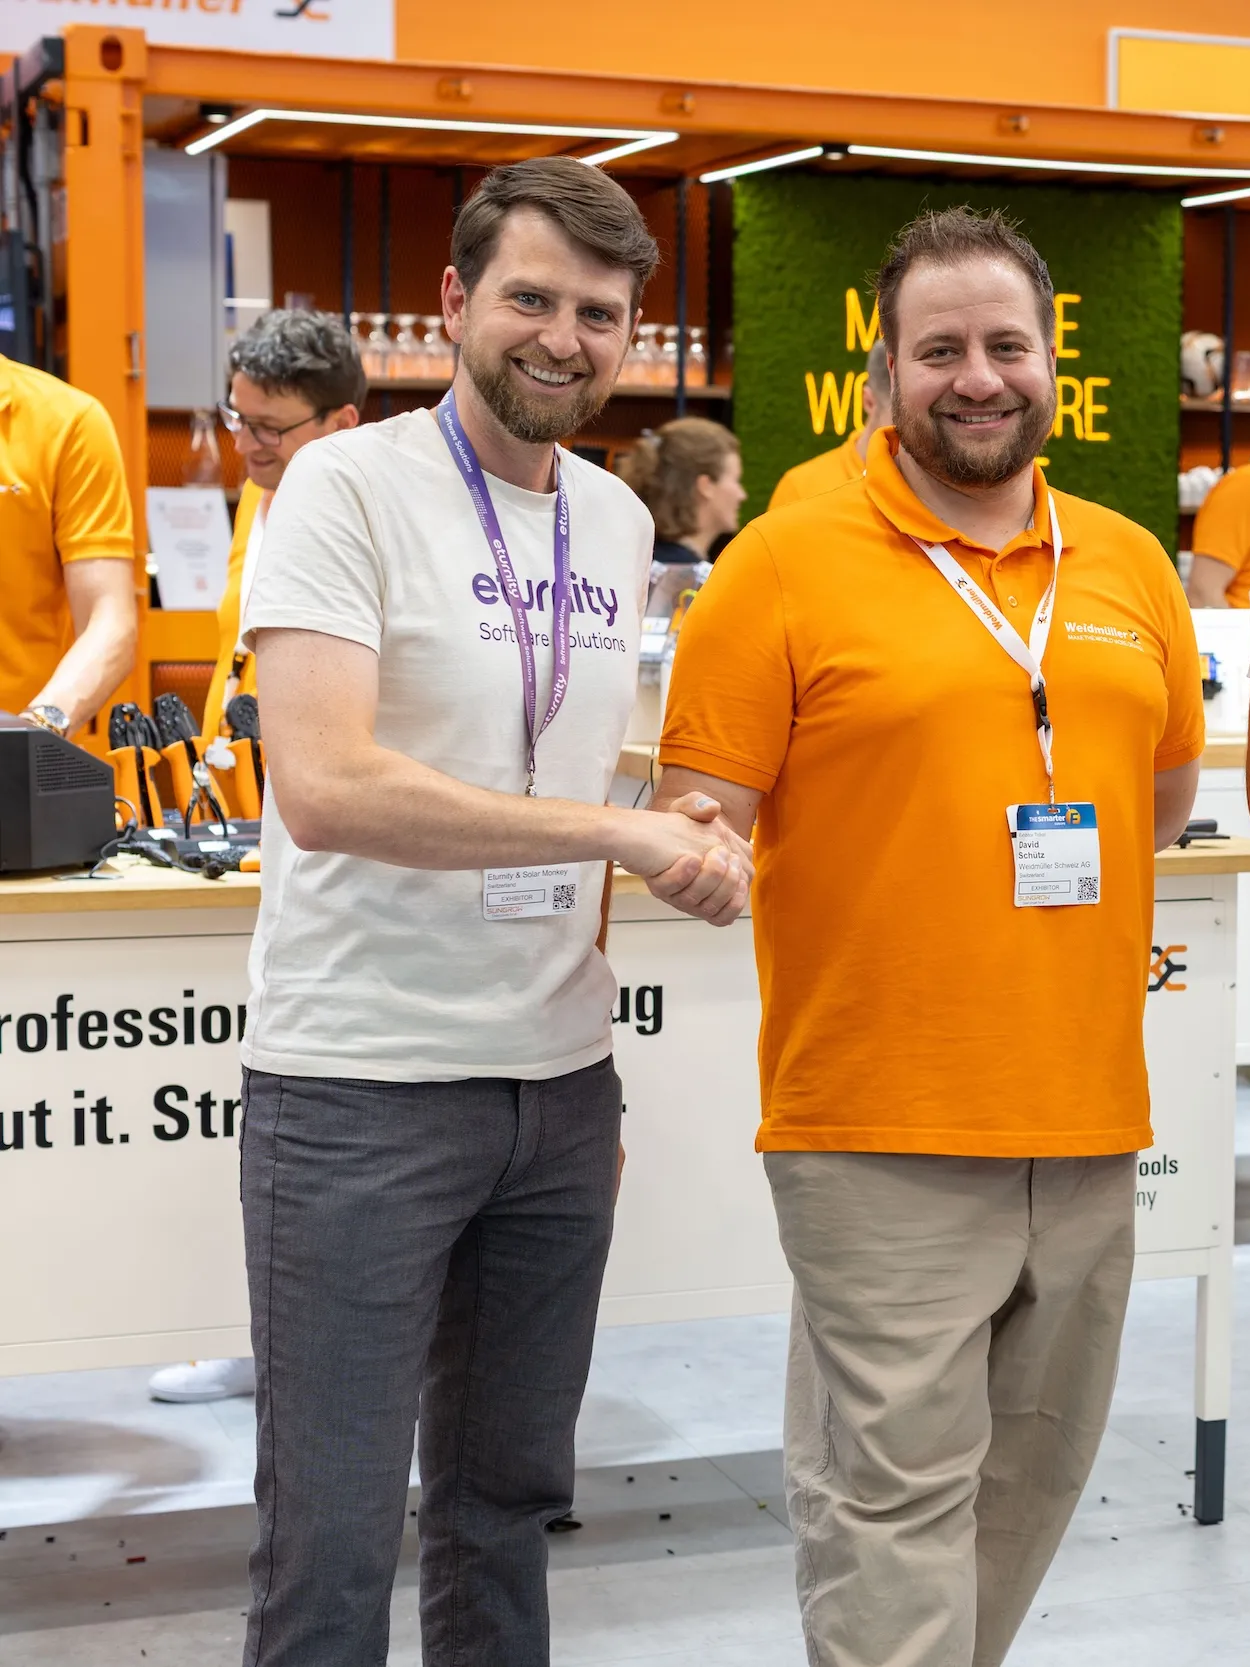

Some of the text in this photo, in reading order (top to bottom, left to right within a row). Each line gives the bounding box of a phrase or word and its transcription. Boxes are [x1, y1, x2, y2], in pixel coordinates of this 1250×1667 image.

[444, 411, 458, 441] Software
[454, 440, 473, 473] Solutions
[493, 538, 520, 598] eturnity
[559, 598, 567, 632] Solutions
[966, 587, 1003, 631] Weidmüller
[480, 622, 626, 652] Softare olutions
[516, 608, 532, 683] Software Solutions
[1064, 622, 1128, 639] Weidmüller
[1018, 851, 1045, 859] Schütz
[1019, 841, 1039, 849] David
[488, 872, 514, 881] Eturnity
[523, 870, 540, 878] Solar
[542, 869, 568, 877] Monkey
[0, 985, 663, 1054] rofessio ug
[0, 1084, 241, 1151] ut it. Str
[1137, 1154, 1178, 1176] ools
